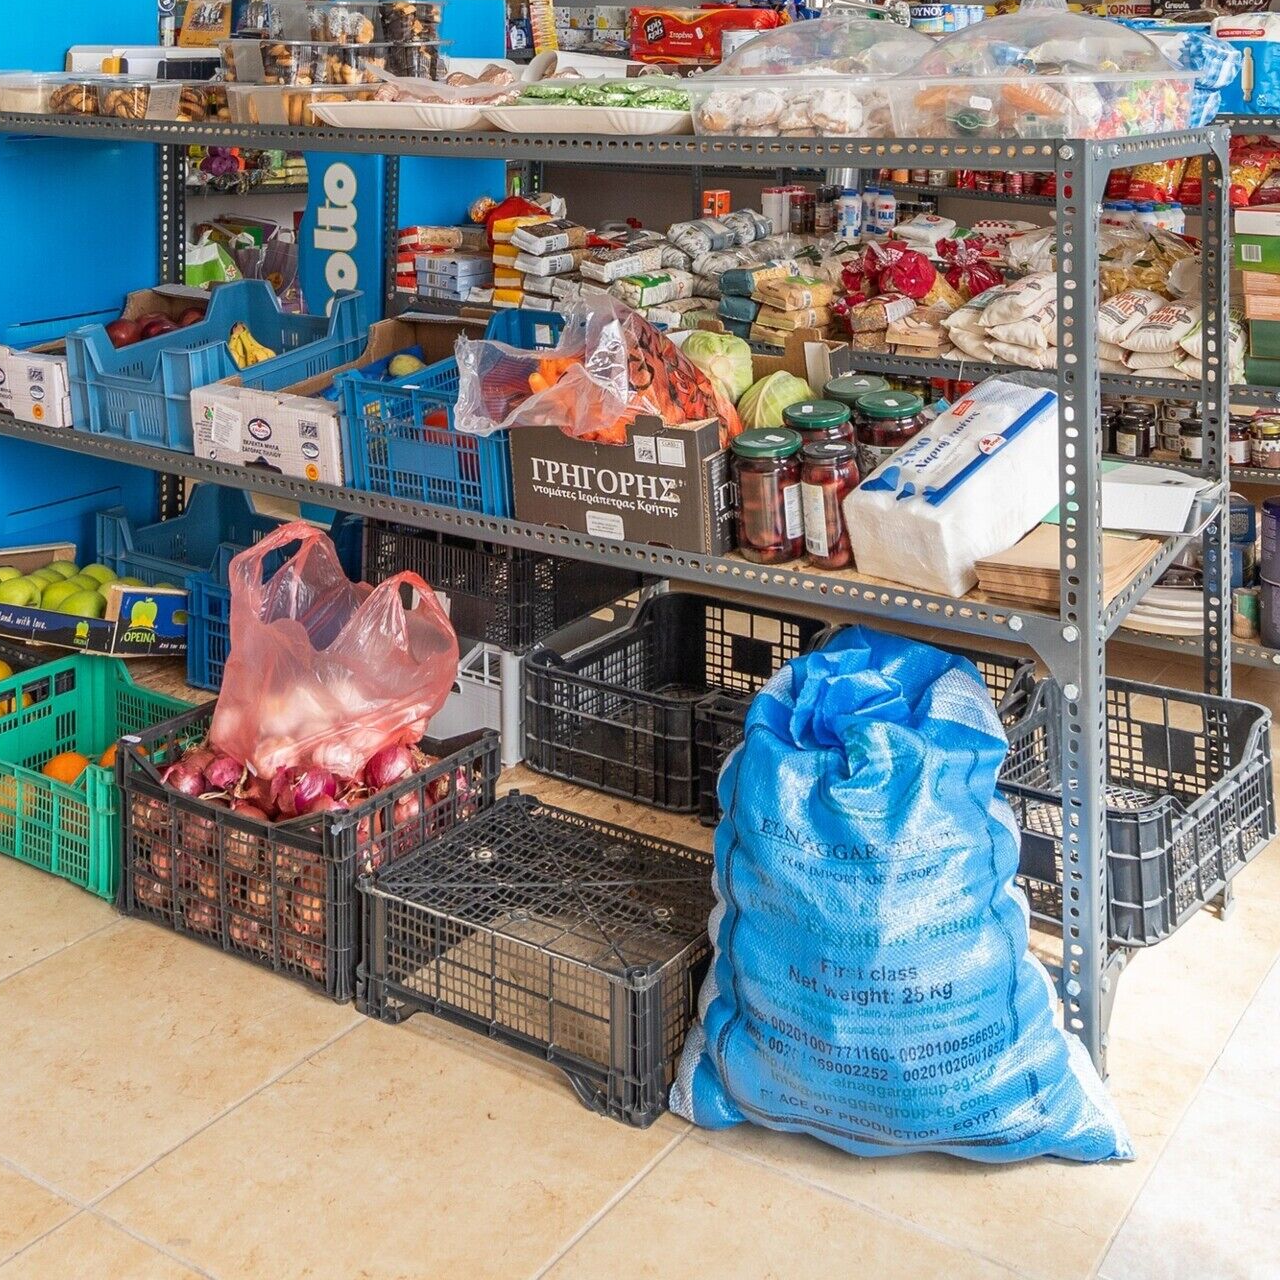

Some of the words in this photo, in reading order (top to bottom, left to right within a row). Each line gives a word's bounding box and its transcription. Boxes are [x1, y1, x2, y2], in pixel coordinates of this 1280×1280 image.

[910, 6, 945, 17] OYNOY
[1164, 0, 1191, 10] Granola
[877, 210, 894, 220] KALAS
[313, 161, 358, 318] olto
[531, 457, 681, 504] ΓΡΗΓΟΡΗΣ
[532, 483, 577, 501] ντομάτες
[578, 489, 636, 511] Ιεράπετρας
[637, 499, 679, 518] Κρήτης
[15, 614, 30, 627] with
[32, 616, 47, 630] love.
[759, 818, 879, 862] ELNAGGAR
[781, 854, 806, 872] FOR
[809, 867, 858, 885] IMPORT
[896, 864, 939, 884] EXPORT
[788, 964, 817, 993] Net
[823, 984, 894, 1005] weight:
[901, 986, 924, 1004] 25
[930, 981, 953, 1000] Kg
[870, 964, 917, 983] class
[760, 1089, 809, 1109] PACE
[814, 1105, 833, 1117] OF
[838, 1111, 939, 1140] PRODUCTION
[953, 1107, 999, 1132] EGYPT
